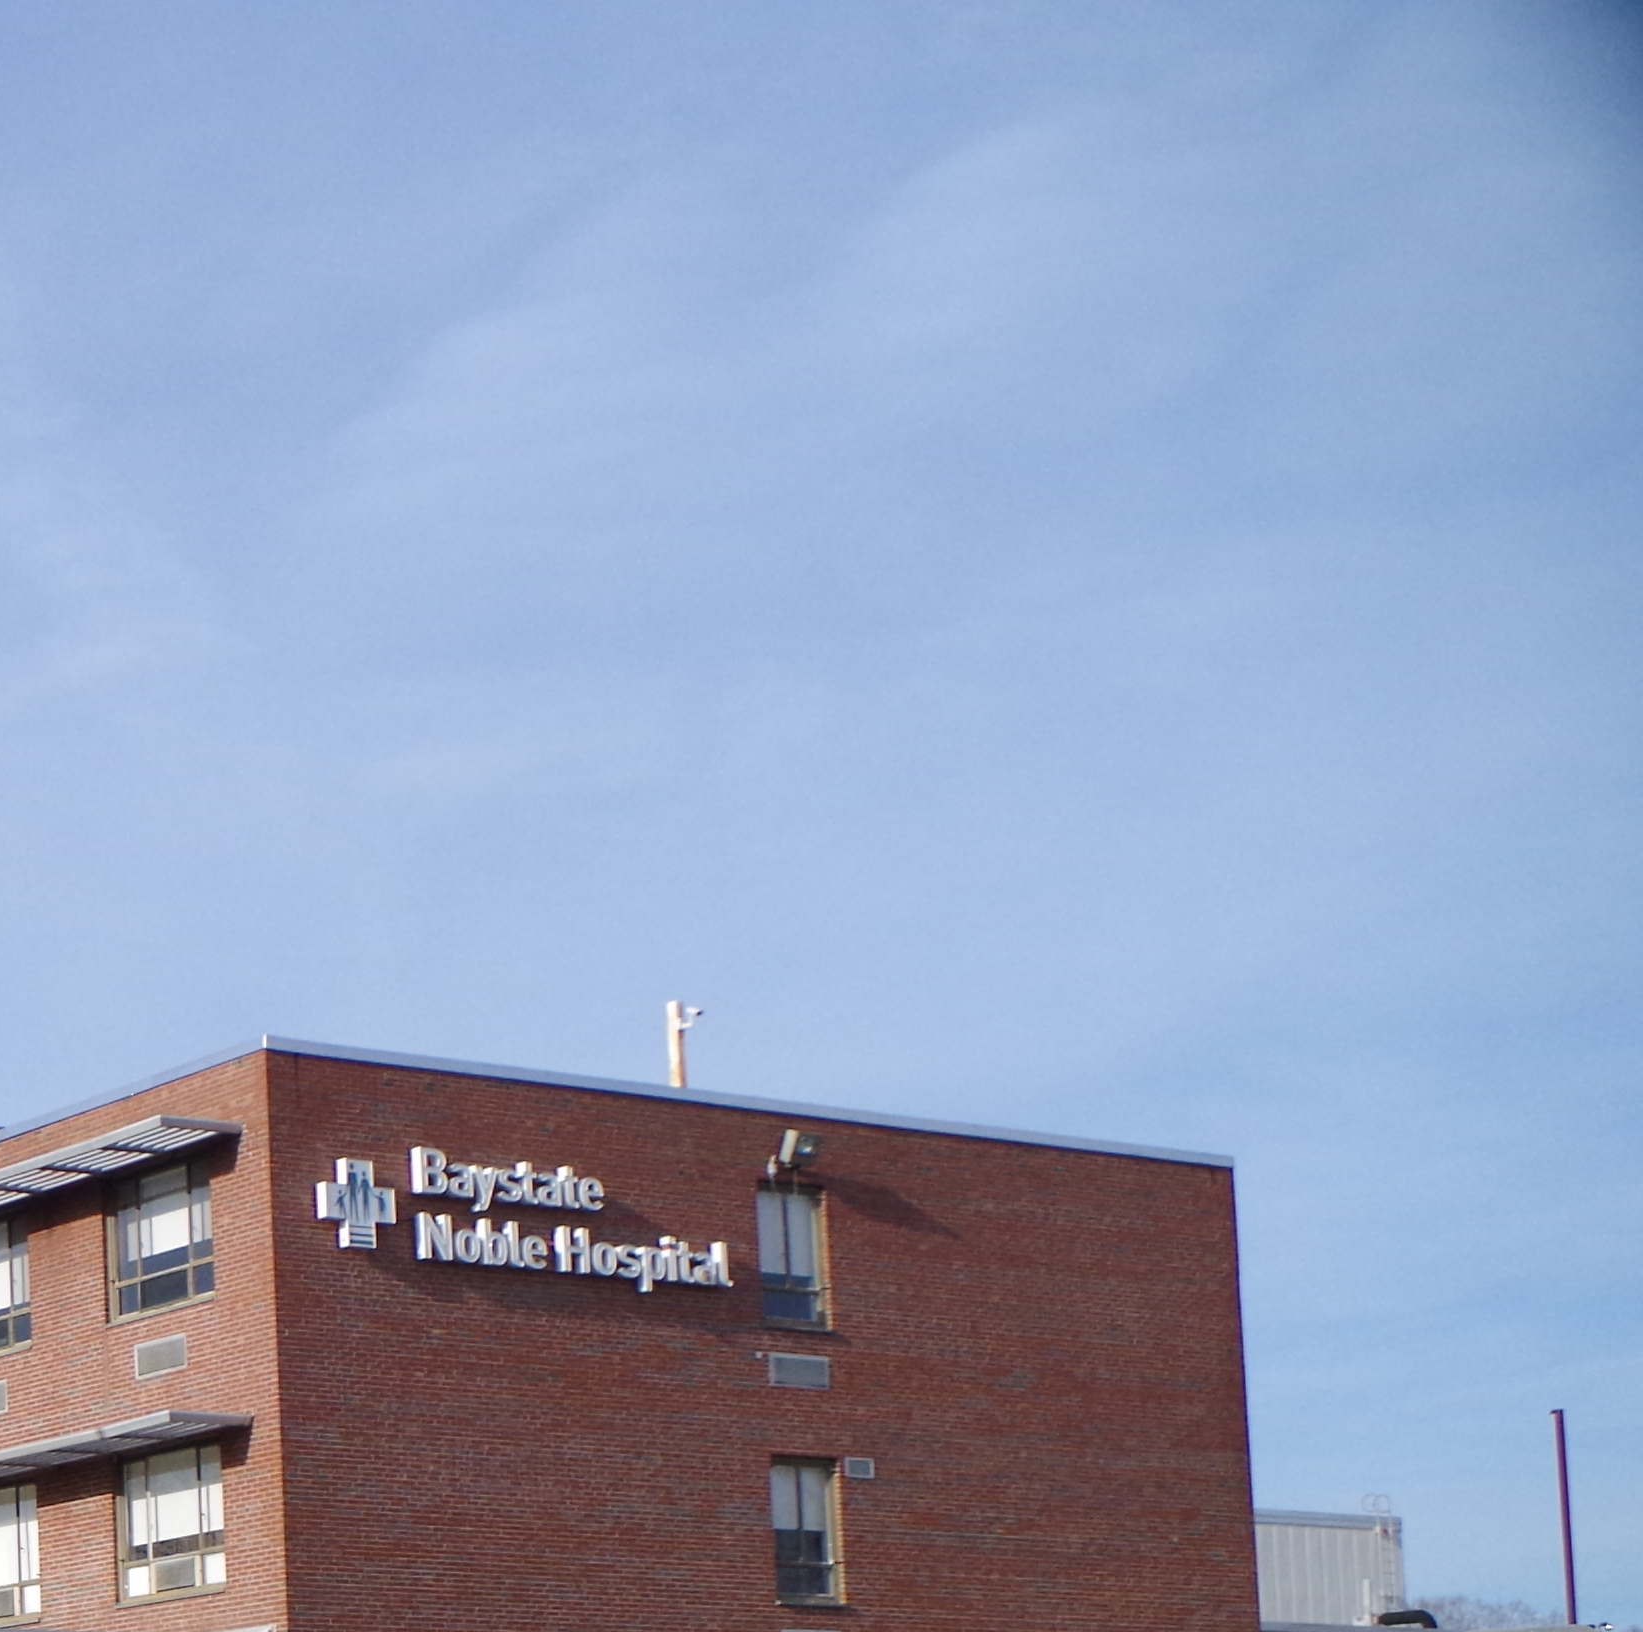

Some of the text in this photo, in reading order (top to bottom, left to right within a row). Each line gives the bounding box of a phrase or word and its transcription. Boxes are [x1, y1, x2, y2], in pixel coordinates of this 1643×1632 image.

[409, 1145, 605, 1213] Baystate
[415, 1211, 734, 1294] Noble Hospital
